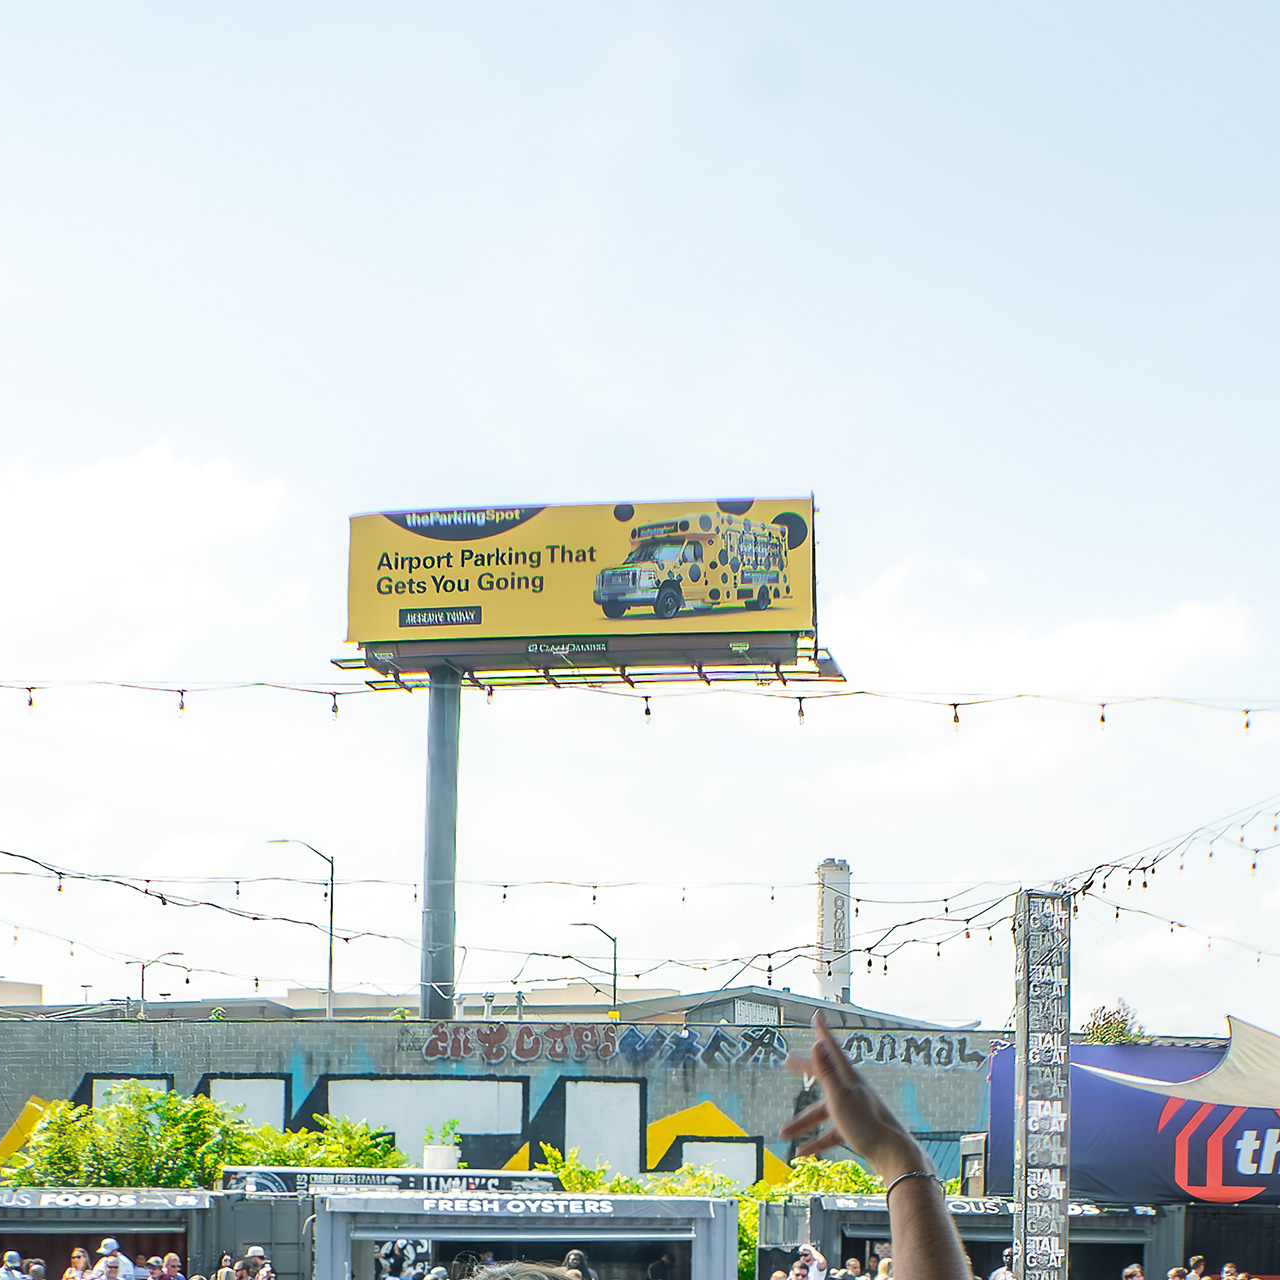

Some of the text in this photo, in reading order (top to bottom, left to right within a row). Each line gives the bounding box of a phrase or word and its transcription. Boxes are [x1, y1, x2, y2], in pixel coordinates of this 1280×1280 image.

[377, 545, 597, 574] Airport Parking That
[376, 572, 544, 595] Gets You Going
[1030, 898, 1068, 915] TAIL
[1030, 966, 1068, 984] TAIL
[1029, 1033, 1067, 1050] TAIL
[1029, 1066, 1066, 1084] TAIL
[1028, 1101, 1067, 1120] TAIL
[1027, 1134, 1066, 1153] TAIL
[1027, 1169, 1066, 1187] TAIL
[39, 1193, 138, 1208] FOODS
[423, 1199, 614, 1214] FRESH OYSTERS
[1027, 1203, 1065, 1221] TAIL
[1026, 1237, 1065, 1255] TAIL
